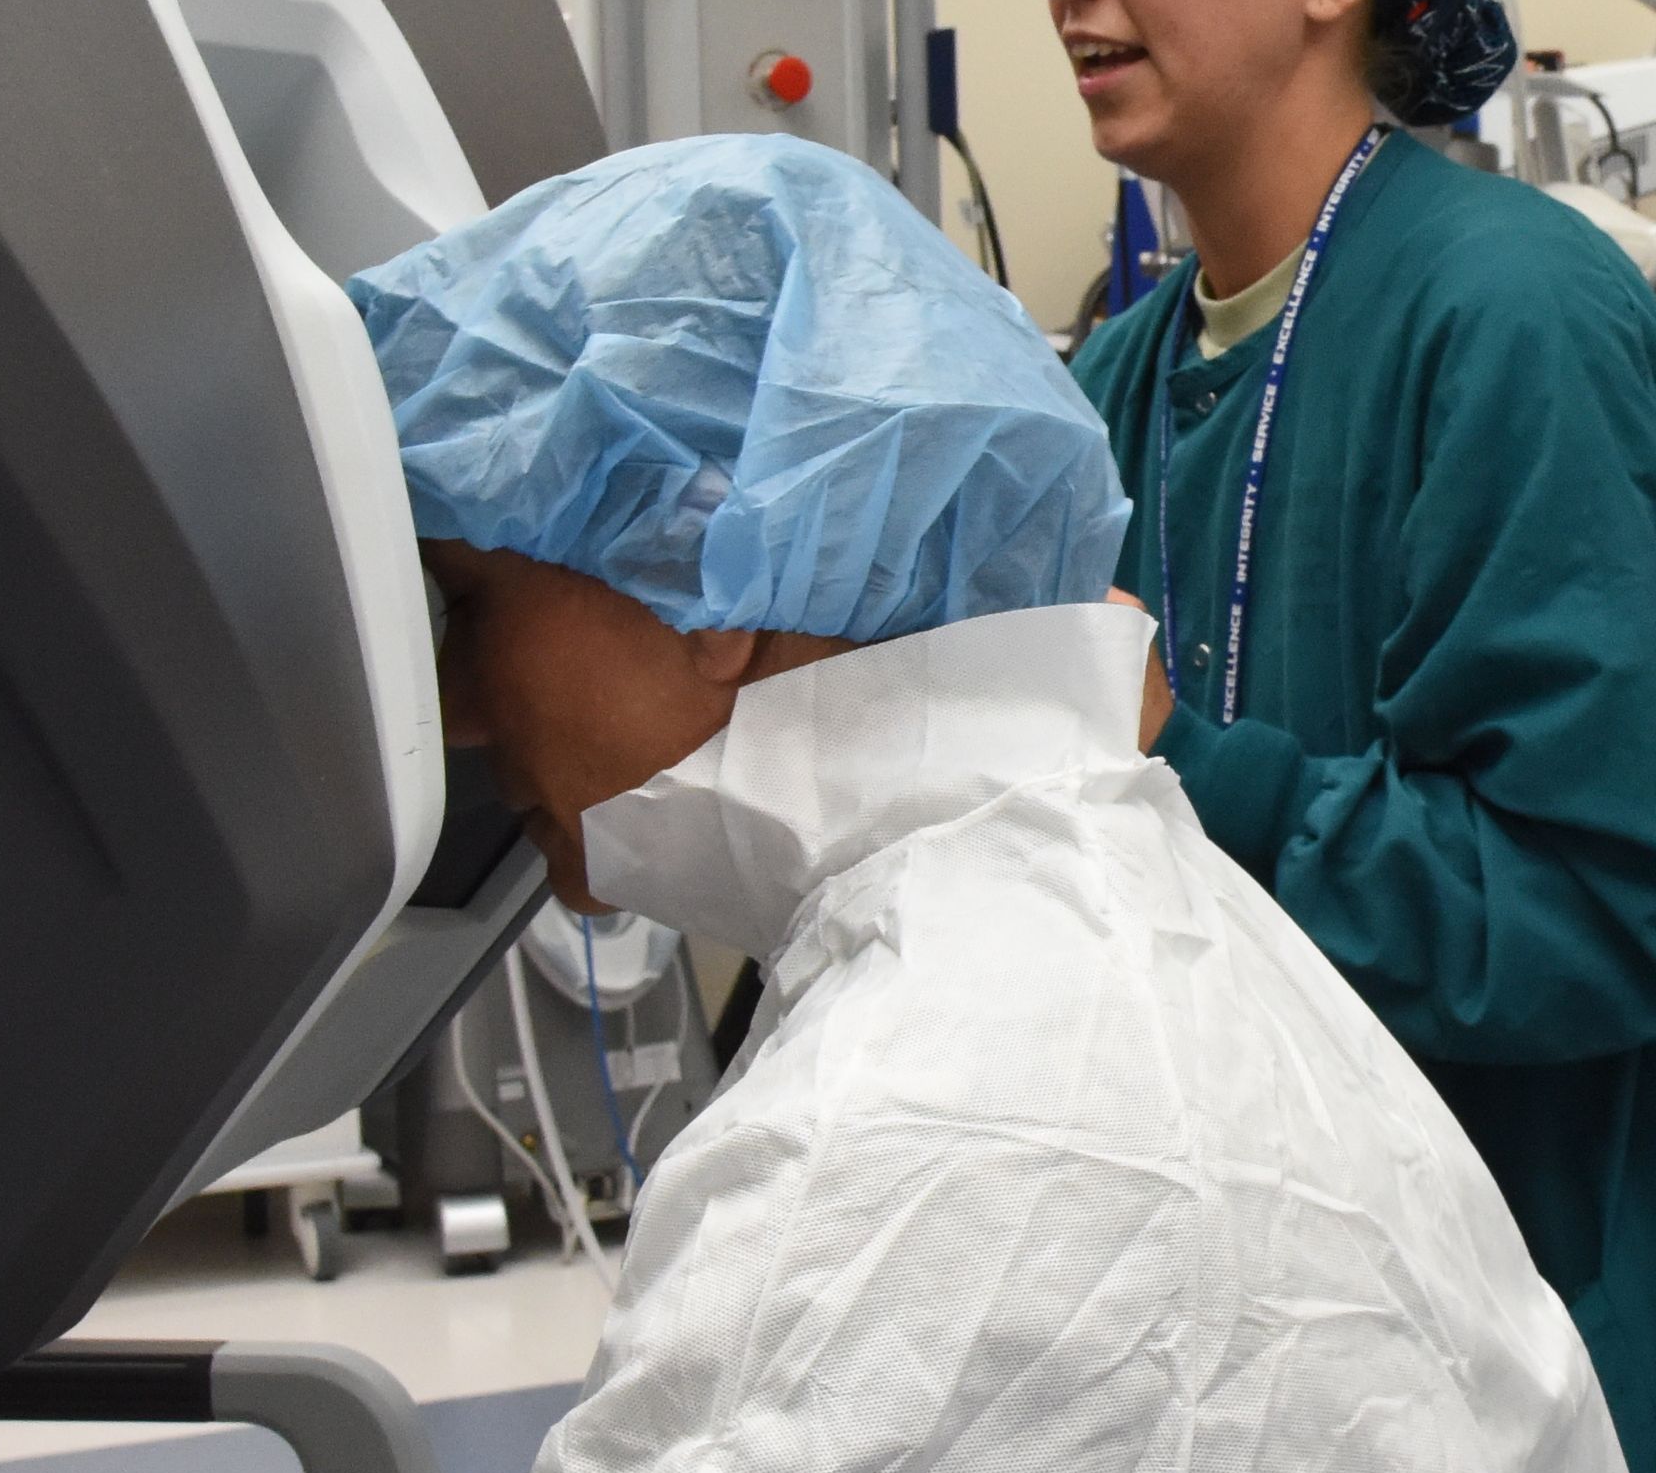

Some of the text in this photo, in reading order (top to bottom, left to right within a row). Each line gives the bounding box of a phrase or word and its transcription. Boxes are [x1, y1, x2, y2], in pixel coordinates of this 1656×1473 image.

[1222, 151, 1365, 725] EXCELLENCE INTEGRITY SERVICE EXCELLENCE INTEGRITY
